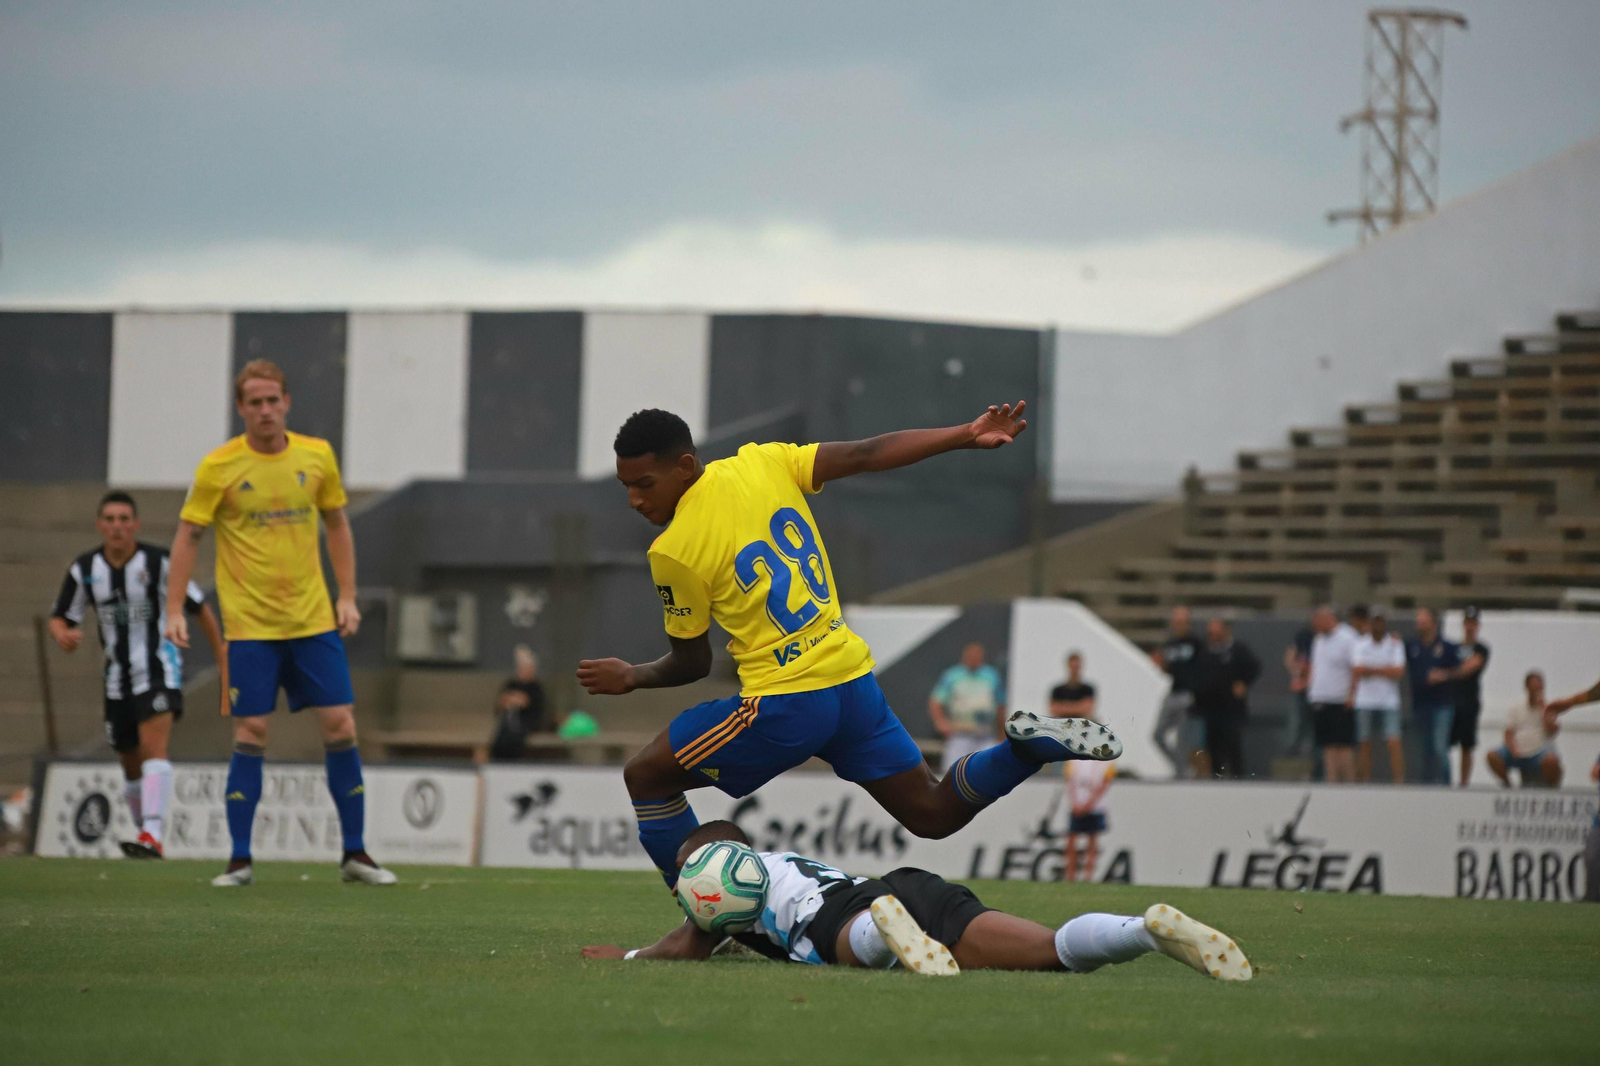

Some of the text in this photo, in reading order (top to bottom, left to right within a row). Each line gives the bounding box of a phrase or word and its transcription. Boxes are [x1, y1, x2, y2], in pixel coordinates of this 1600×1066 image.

[735, 507, 831, 637] 28
[773, 641, 802, 667] VS
[1209, 849, 1384, 895] LEGEA
